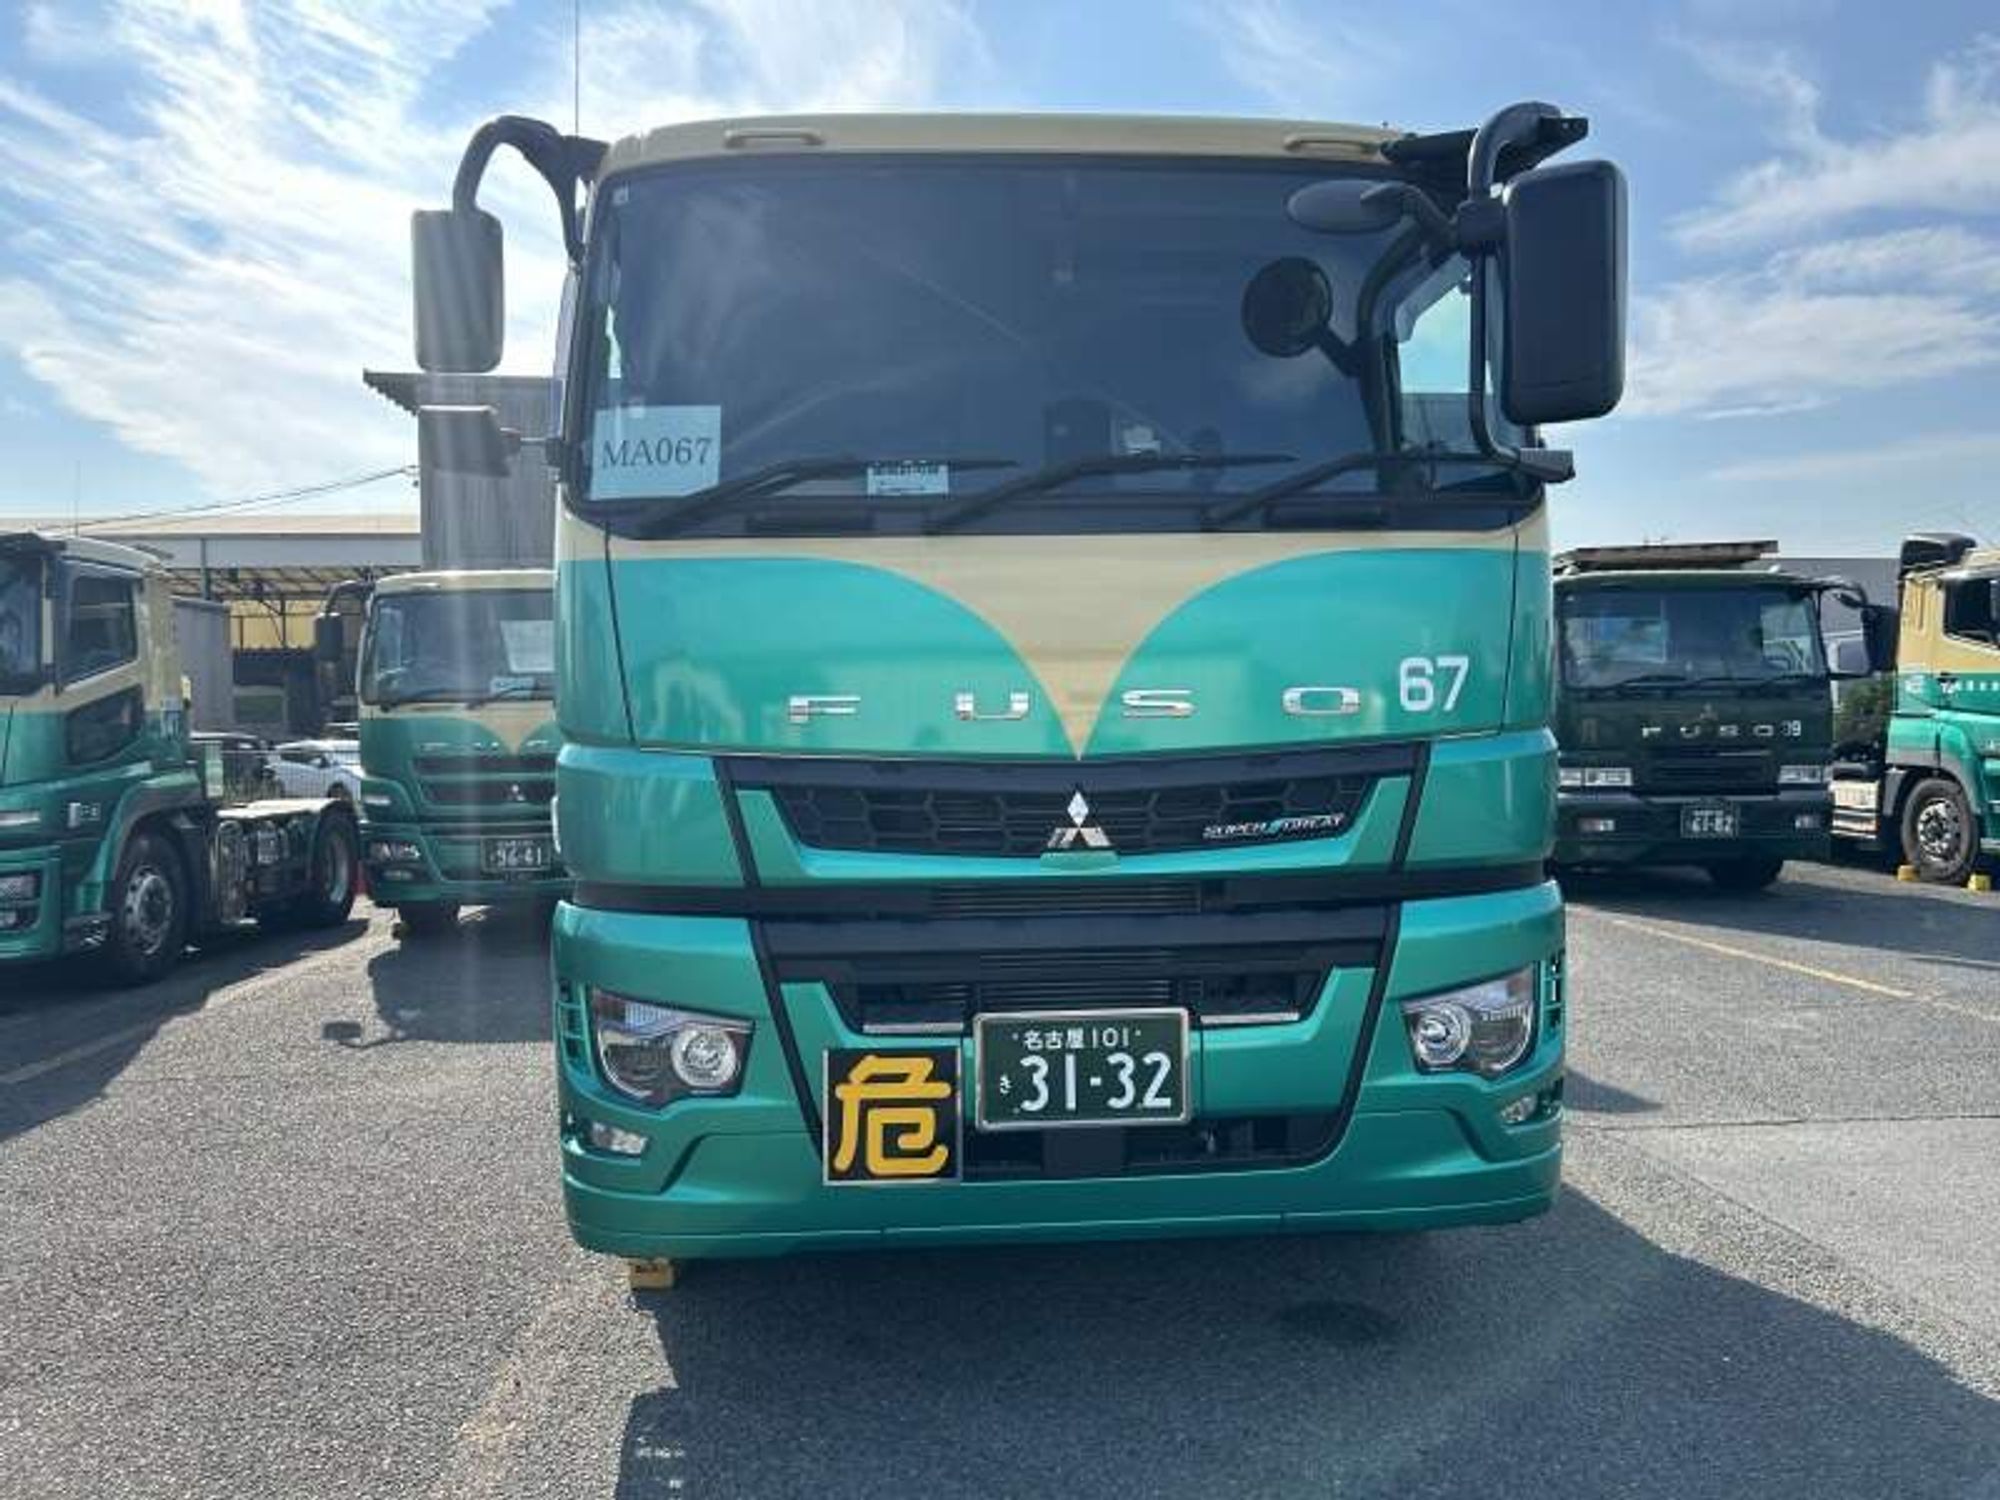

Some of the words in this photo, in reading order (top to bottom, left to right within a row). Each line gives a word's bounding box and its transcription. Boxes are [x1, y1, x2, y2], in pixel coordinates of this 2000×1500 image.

[603, 437, 712, 468] MA067
[788, 687, 1361, 722] FUSO
[1399, 656, 1469, 711] 67
[1019, 1052, 1172, 1112] 31-32
[834, 1054, 952, 1177] 危
